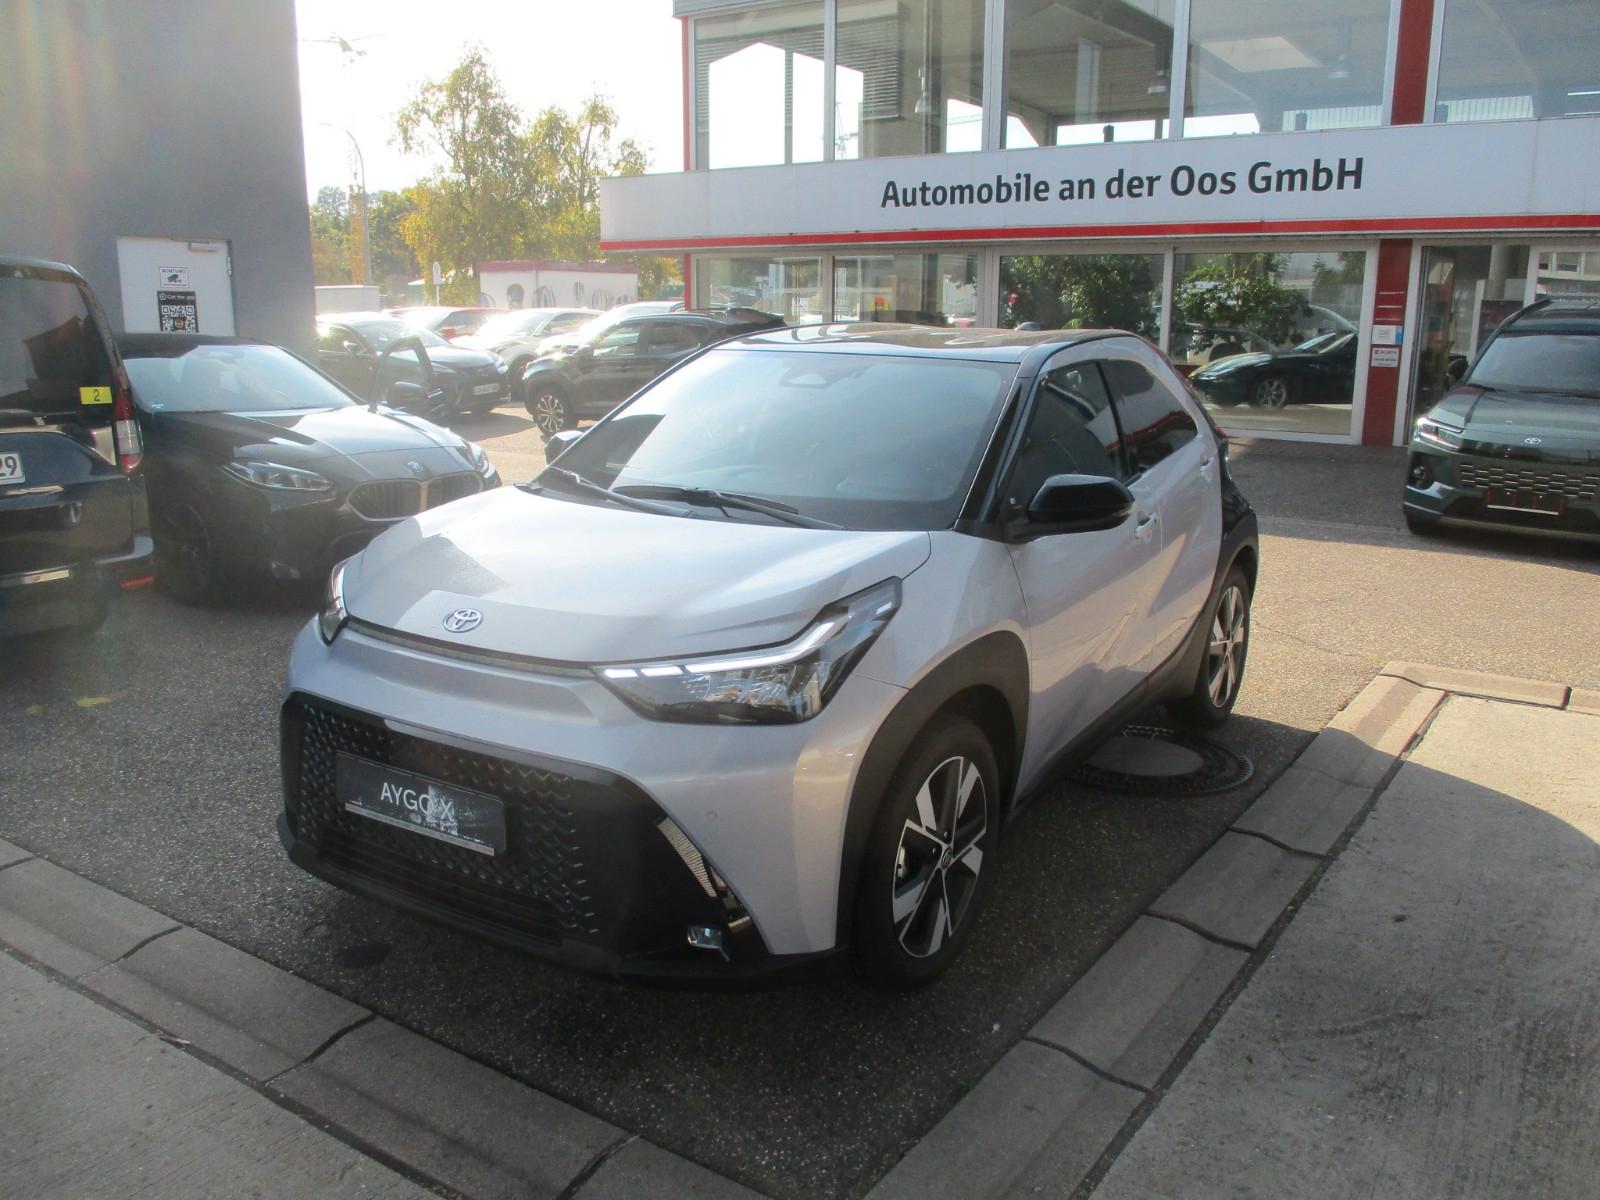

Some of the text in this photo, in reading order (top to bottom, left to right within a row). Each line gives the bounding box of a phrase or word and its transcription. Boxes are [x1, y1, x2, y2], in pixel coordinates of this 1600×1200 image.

[881, 157, 1364, 208] Automobile an der Oos GmbH
[93, 389, 101, 402] 2
[380, 782, 455, 821] AYGO X
